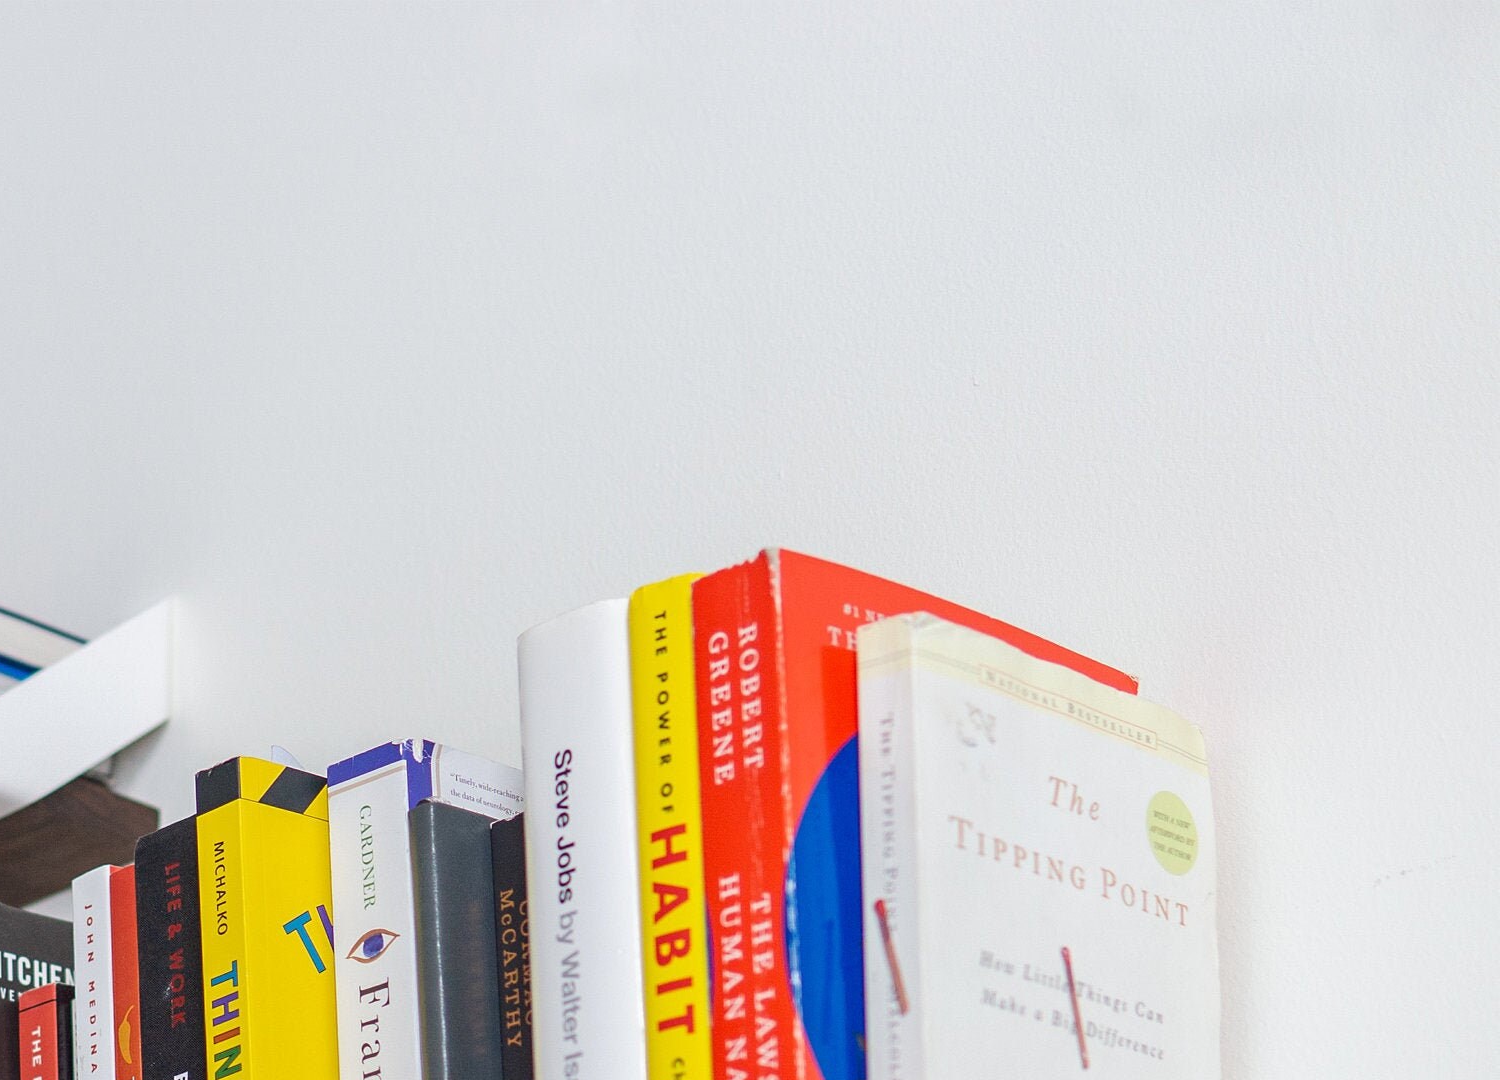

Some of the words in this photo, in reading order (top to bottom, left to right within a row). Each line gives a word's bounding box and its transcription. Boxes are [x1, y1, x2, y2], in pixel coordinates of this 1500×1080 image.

[654, 610, 668, 657] THE
[657, 671, 673, 767] POWER
[708, 631, 736, 786] GREENE
[738, 620, 765, 770] ROBERT
[985, 671, 1059, 710] NATIONAL
[1067, 702, 1153, 746] BESTSELLER
[450, 788, 461, 798] the
[462, 792, 475, 803] data
[554, 748, 573, 829] Steve
[660, 782, 675, 814] OF
[1049, 775, 1100, 821] The
[164, 860, 182, 914] LIFE
[214, 841, 228, 936] MICHALKO
[360, 804, 377, 911] GARDNER
[556, 834, 578, 906] Jobs
[948, 815, 1086, 891] TIPPING
[1100, 867, 1189, 927] POINT
[85, 904, 95, 963] JOHN
[167, 923, 183, 941] &
[500, 887, 522, 1047] McCARTHY
[555, 910, 575, 945] by
[649, 823, 695, 1035] HABIT
[717, 872, 747, 1022] HUMAN
[750, 892, 775, 973] THE
[88, 980, 98, 1075] MEDINA
[169, 948, 186, 1028] WORK
[560, 949, 583, 1047] Walter
[1134, 1000, 1165, 1025] Can
[31, 1025, 42, 1066] THE
